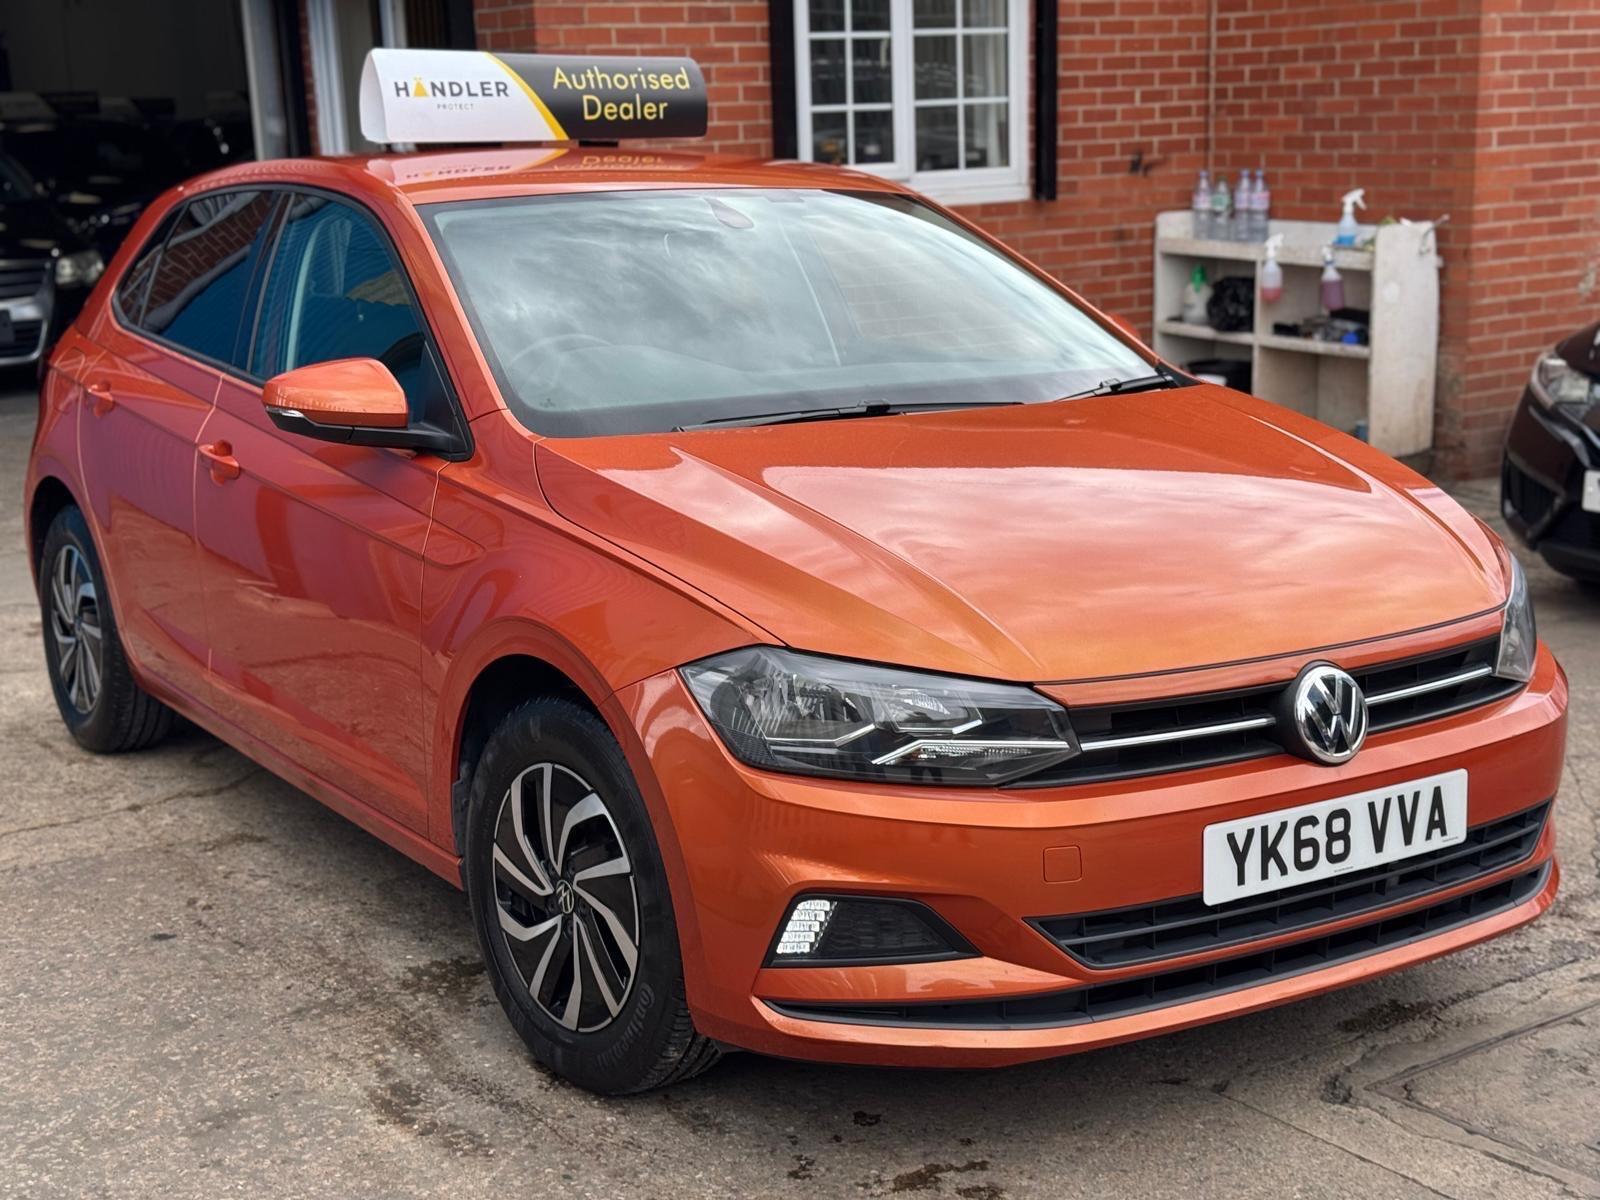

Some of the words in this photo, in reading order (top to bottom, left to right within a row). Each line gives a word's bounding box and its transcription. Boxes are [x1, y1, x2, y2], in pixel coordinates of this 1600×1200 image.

[553, 66, 690, 90] Authorised
[437, 103, 474, 111] PROTECT
[582, 93, 668, 120] Dealer
[1227, 808, 1351, 886] YK68
[1368, 786, 1447, 853] VVA
